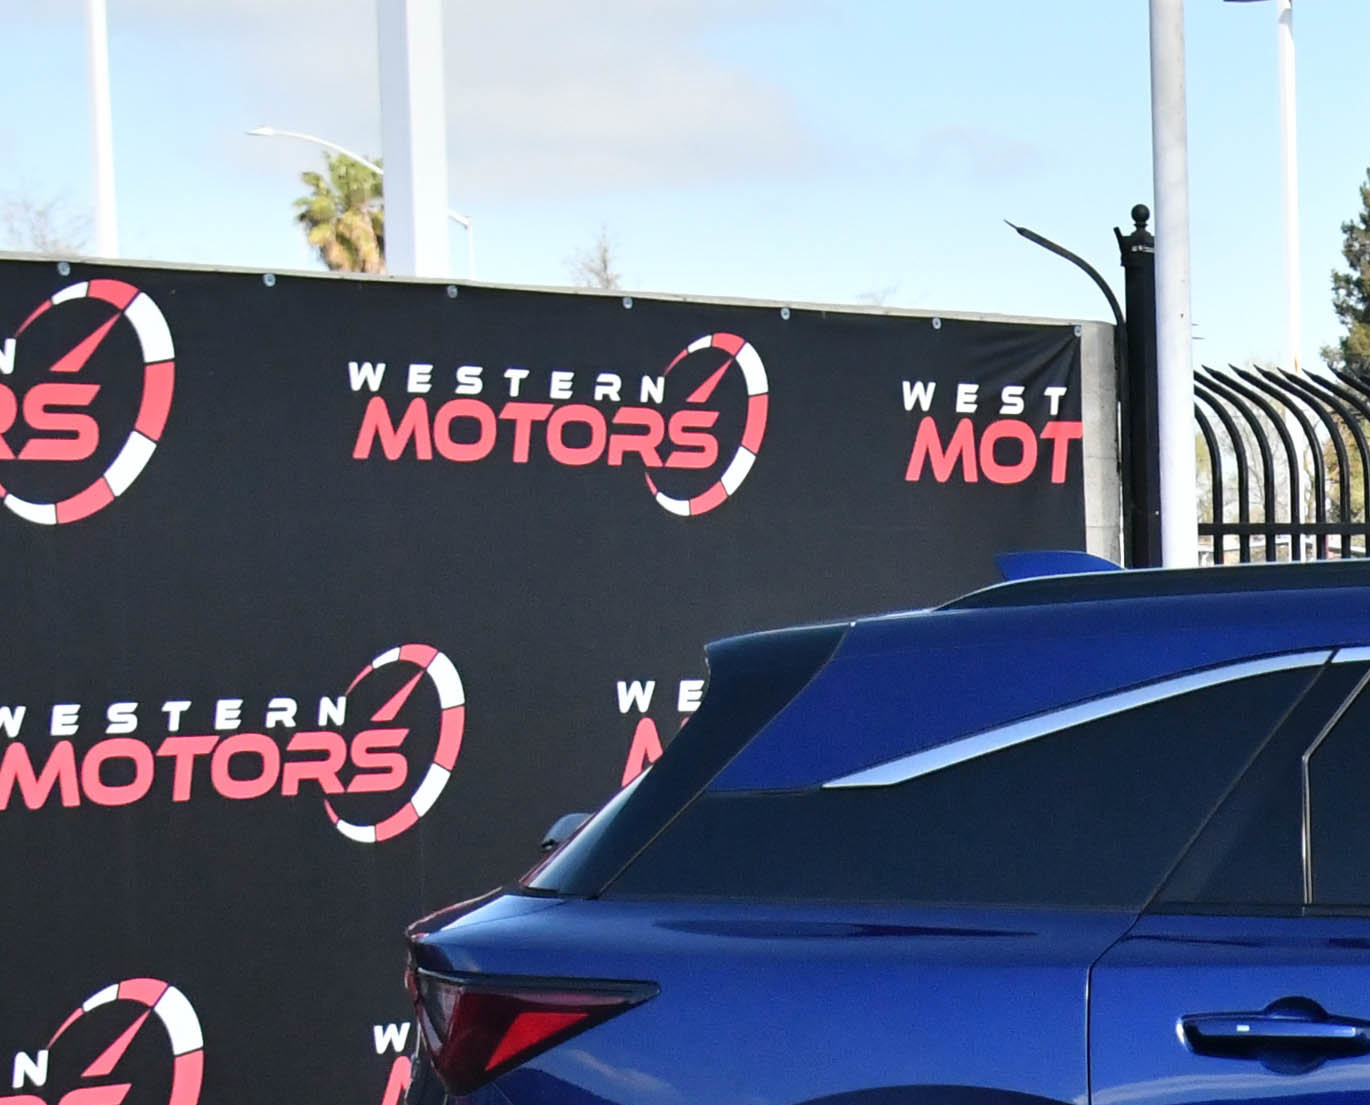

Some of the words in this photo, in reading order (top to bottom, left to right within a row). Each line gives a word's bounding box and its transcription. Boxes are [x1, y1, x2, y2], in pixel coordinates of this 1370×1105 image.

[348, 361, 665, 404] WESTERN
[902, 380, 1068, 416] WEST
[0, 382, 101, 461] S
[352, 395, 720, 469] MOTORS
[905, 415, 1085, 485] MOT
[0, 695, 347, 738] WESTERN
[0, 727, 410, 811] MOTORS
